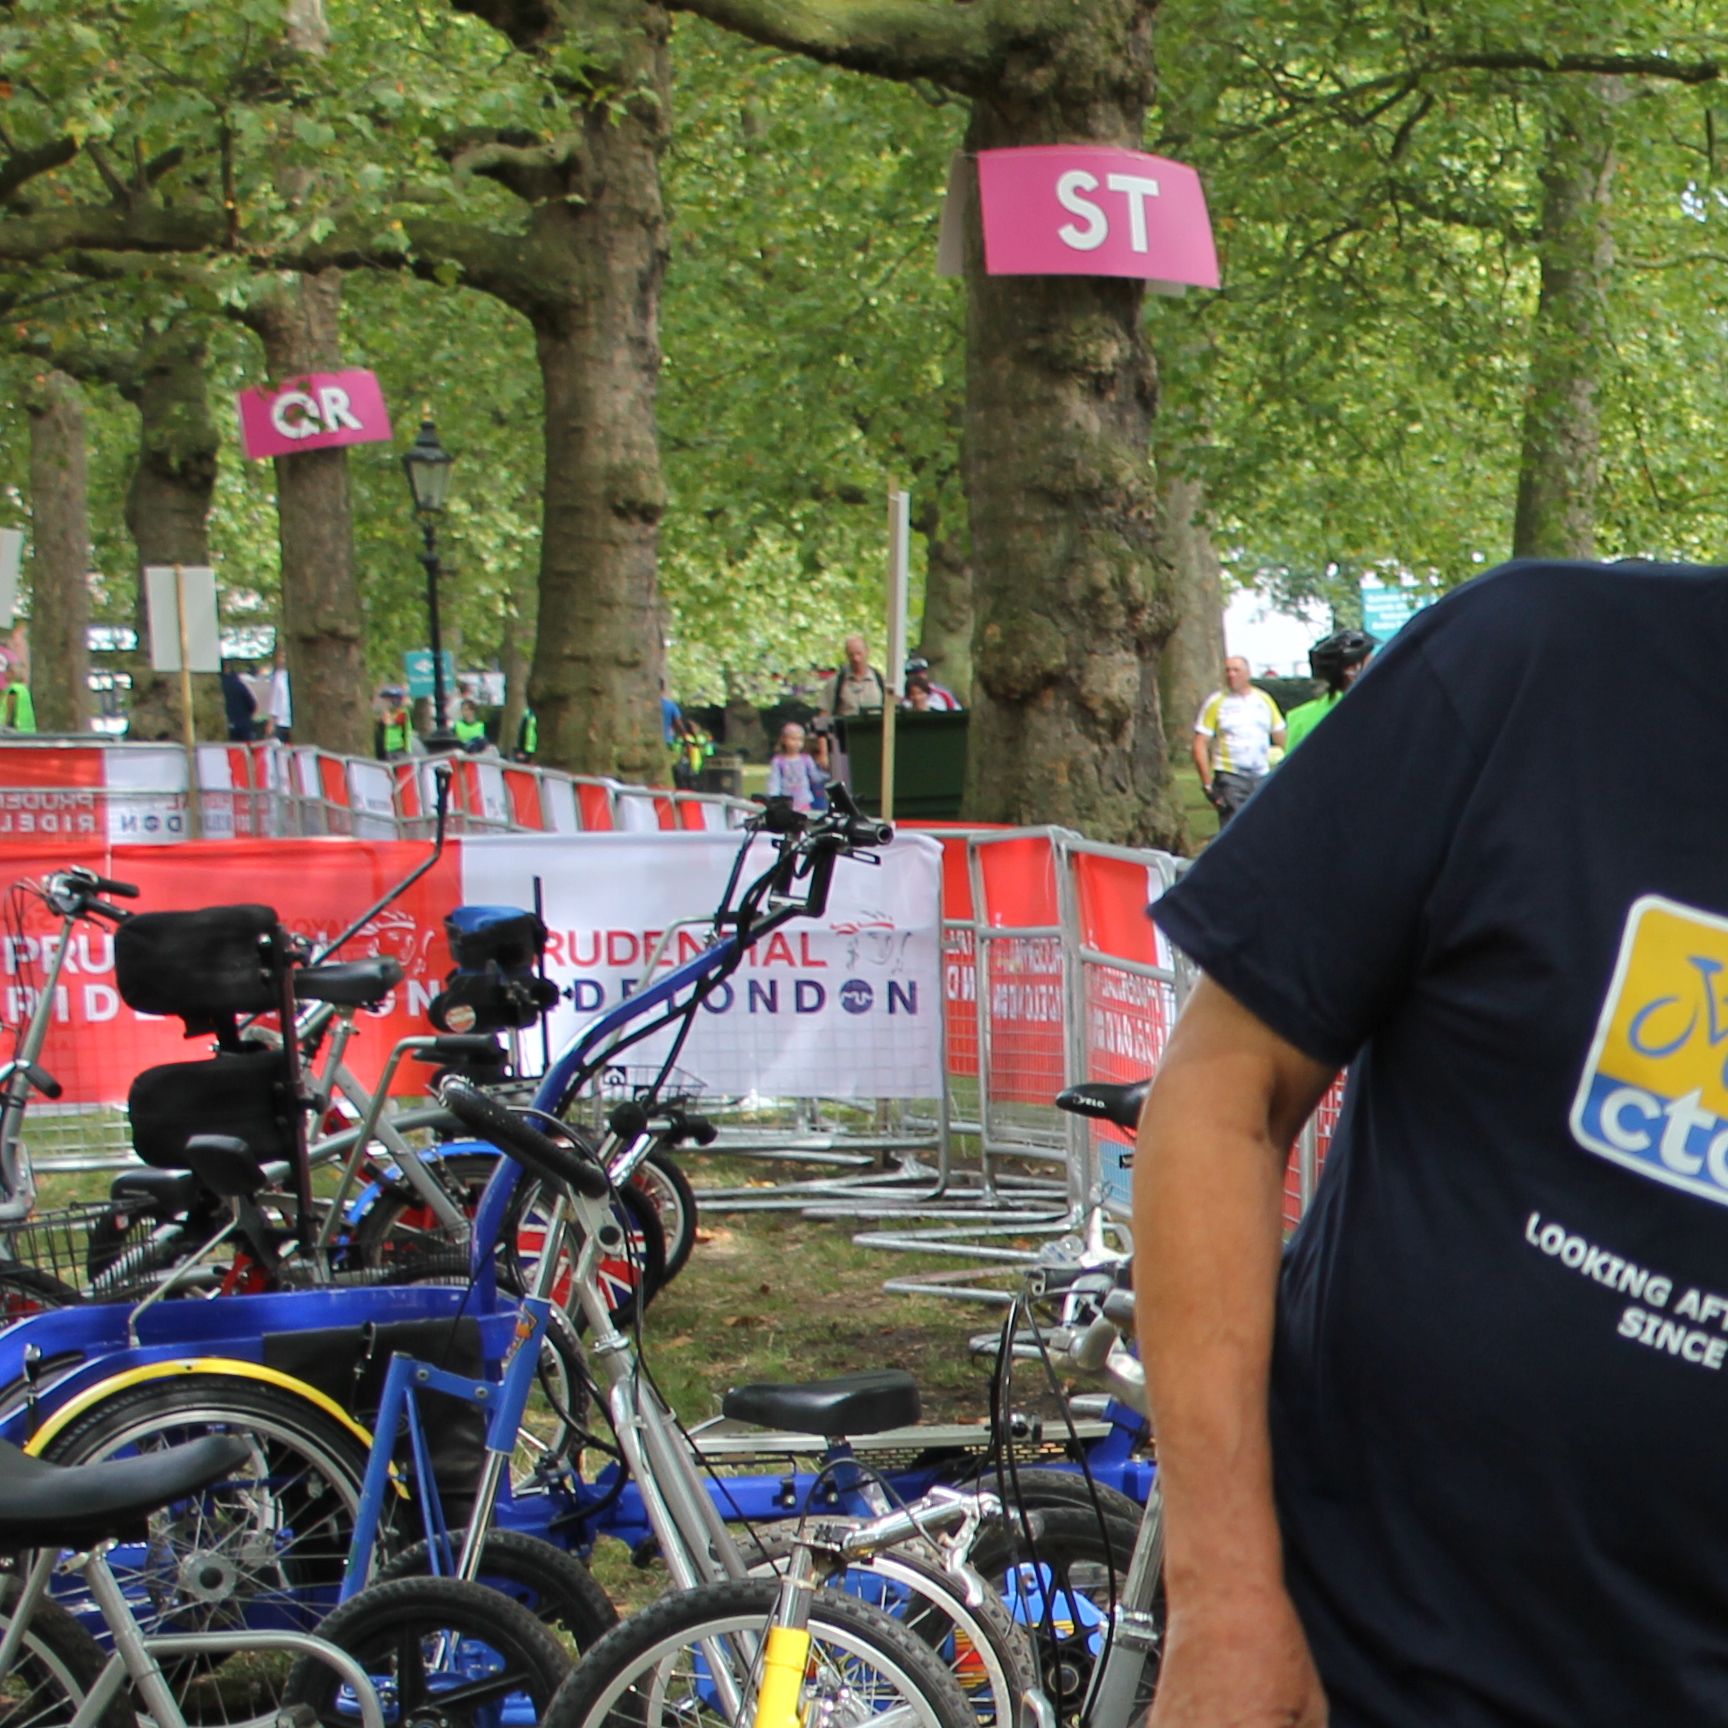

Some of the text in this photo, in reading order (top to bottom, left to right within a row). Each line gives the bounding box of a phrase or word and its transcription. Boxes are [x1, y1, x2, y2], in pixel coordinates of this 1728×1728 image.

[1056, 168, 1160, 254] ST
[271, 386, 364, 440] QR
[532, 930, 827, 967] RUDENIAL
[1525, 1211, 1673, 1306] LOOKING
[1617, 1305, 1728, 1370] SINCE
